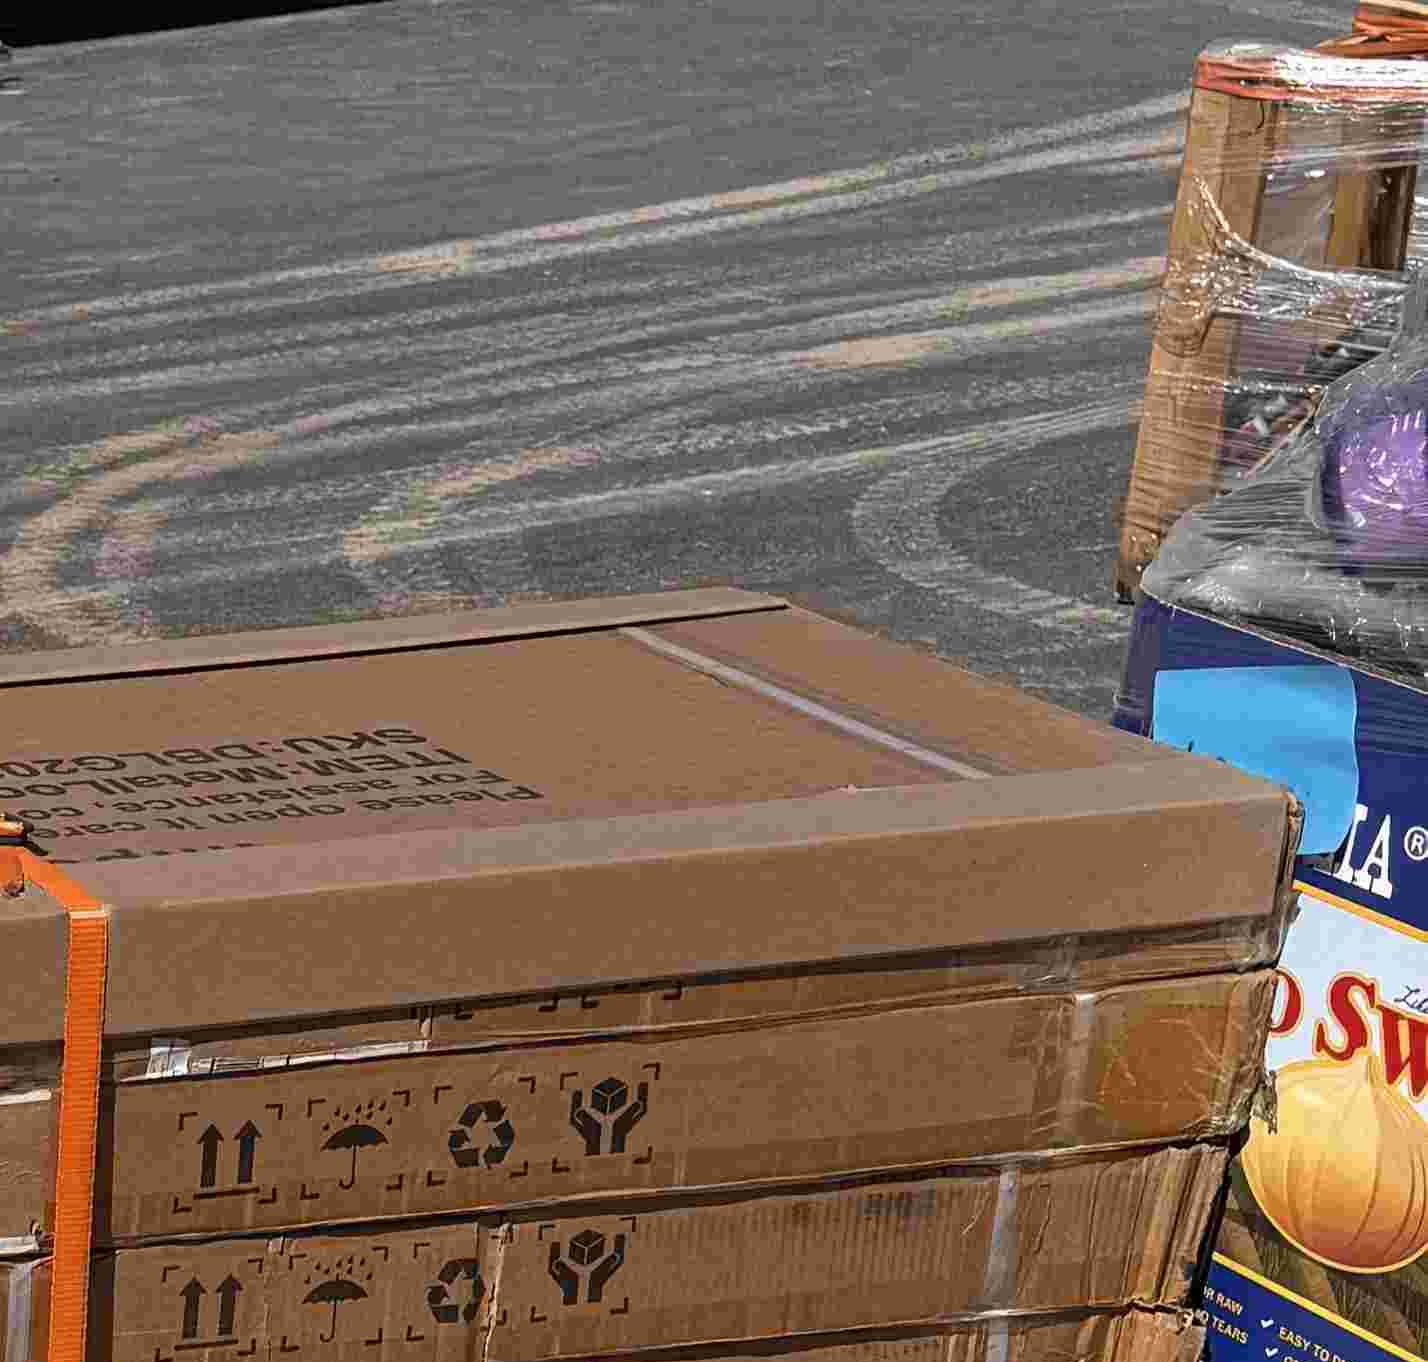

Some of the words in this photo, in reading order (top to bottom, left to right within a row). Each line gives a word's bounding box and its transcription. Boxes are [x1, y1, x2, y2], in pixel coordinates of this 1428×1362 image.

[412, 768, 511, 788] For
[358, 784, 544, 810] Please
[207, 802, 345, 823] open
[1215, 1292, 1244, 1315] RAW
[1212, 1315, 1249, 1344] TEARS
[1279, 1326, 1312, 1352] EASY
[1312, 1342, 1331, 1362] TO
